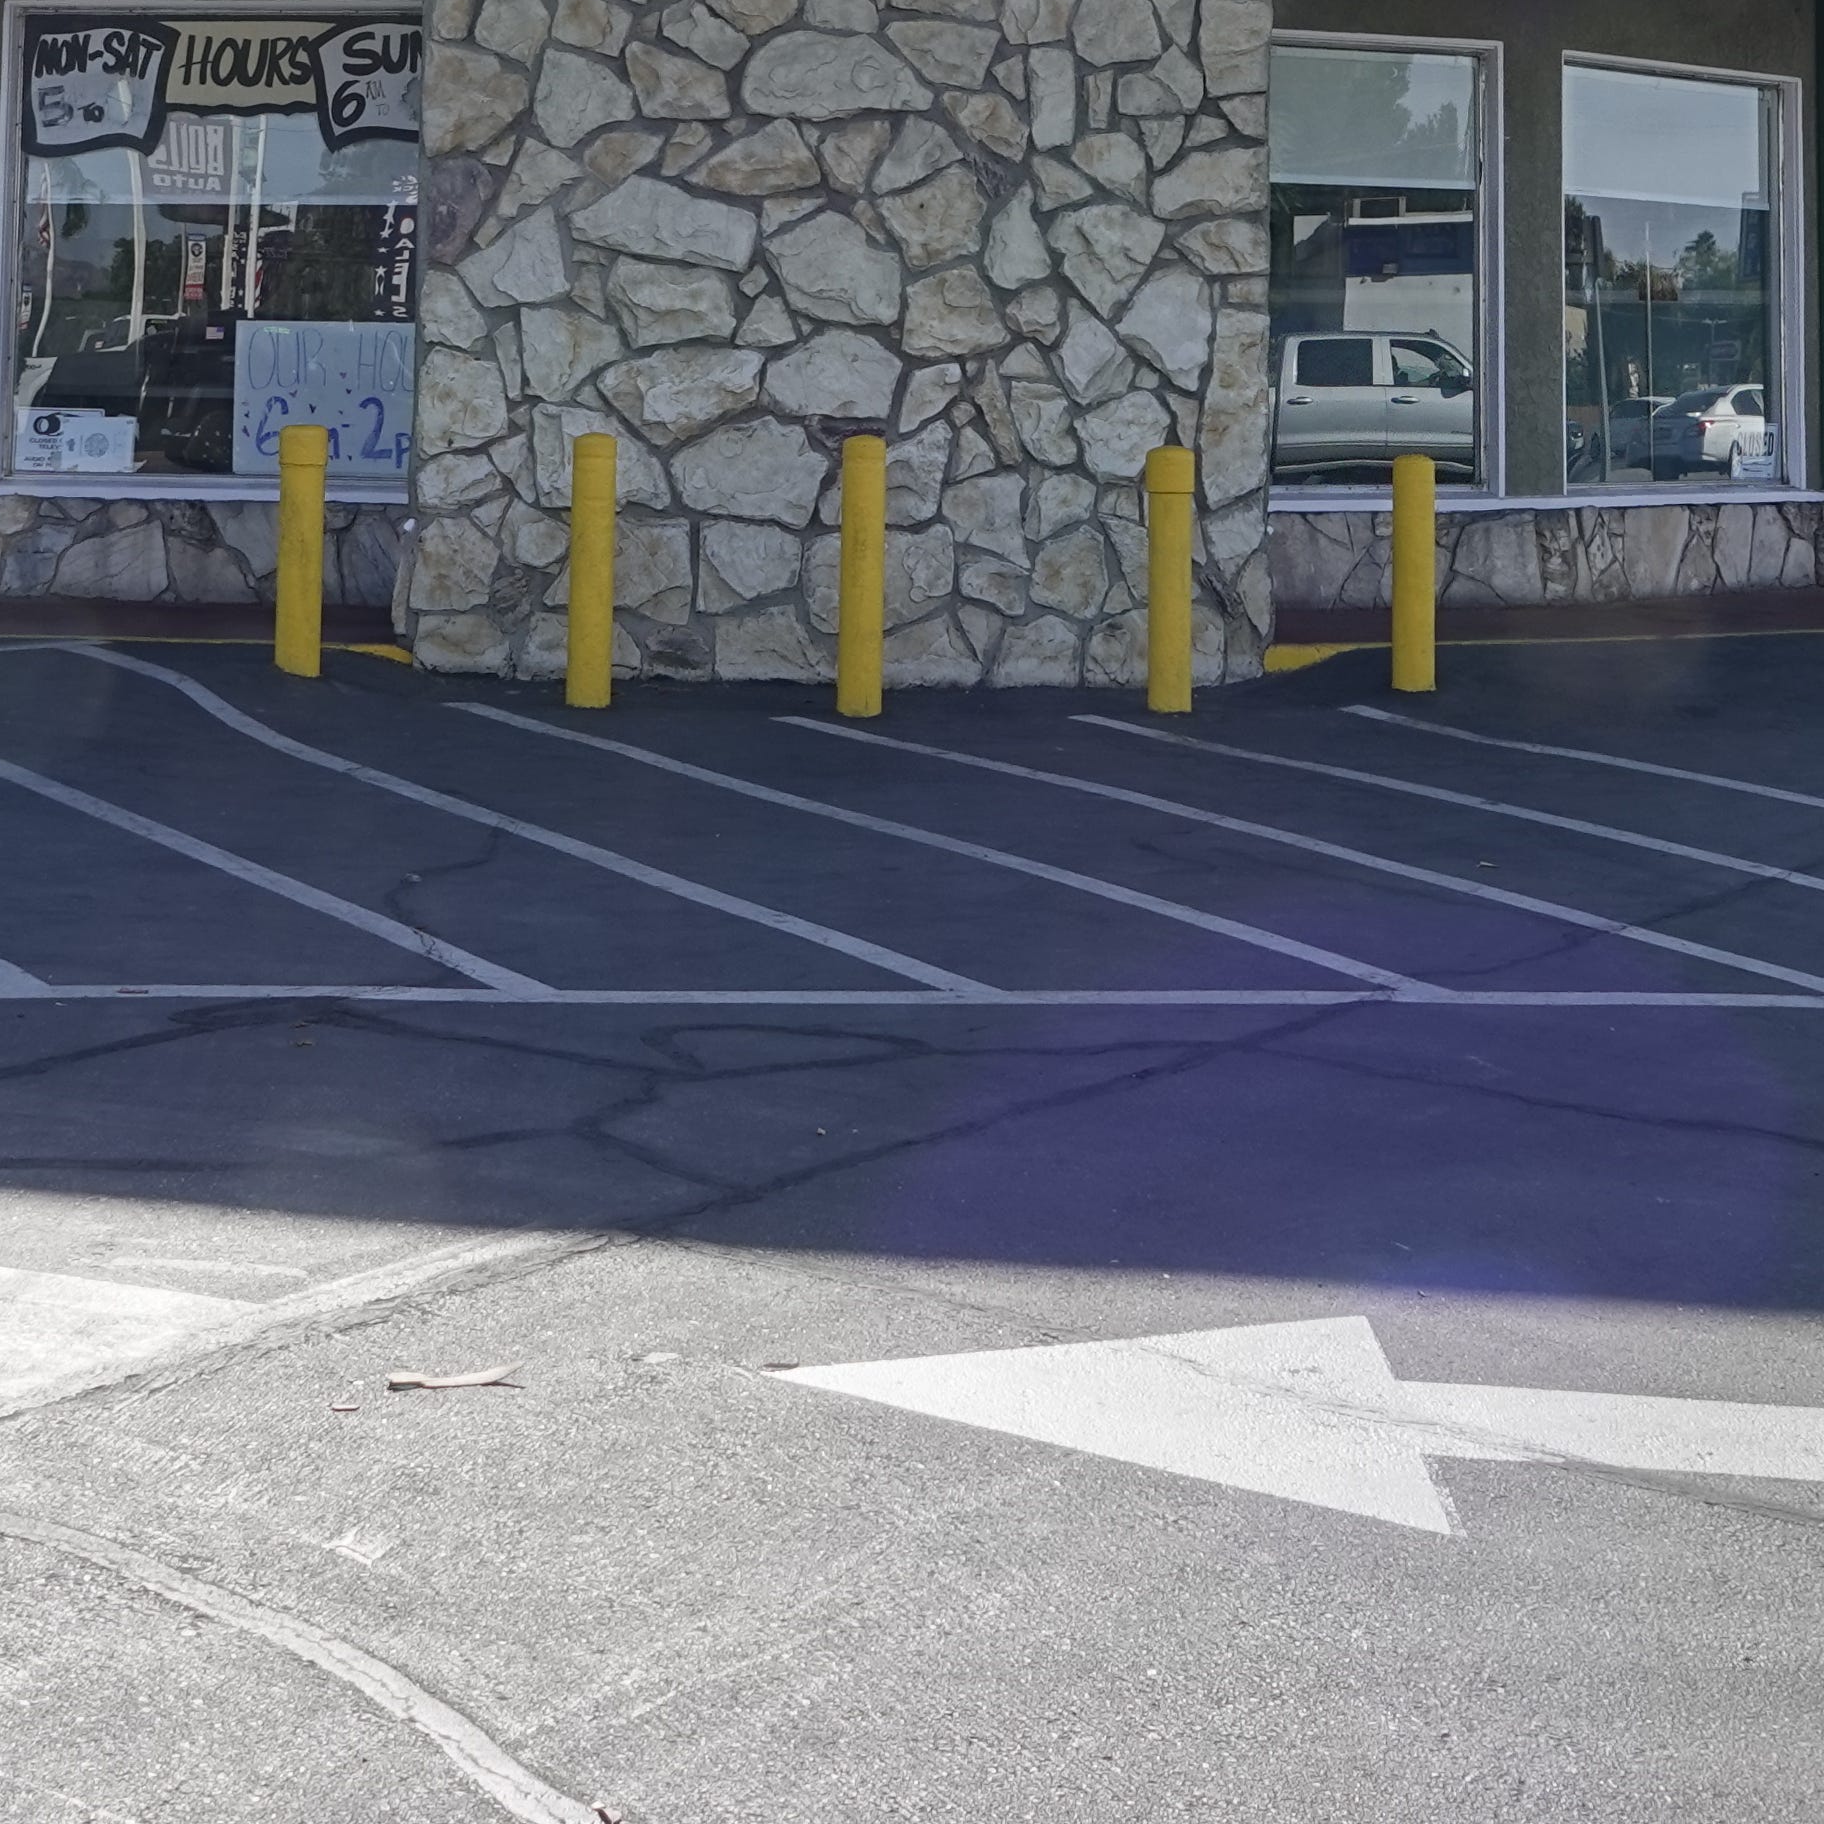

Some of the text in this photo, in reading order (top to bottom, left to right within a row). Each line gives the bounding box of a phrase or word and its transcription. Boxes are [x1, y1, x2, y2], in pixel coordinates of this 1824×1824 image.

[34, 31, 163, 80] MON-SAT
[178, 34, 313, 88] HOURS
[331, 80, 366, 128] 6
[248, 327, 327, 391] OUR
